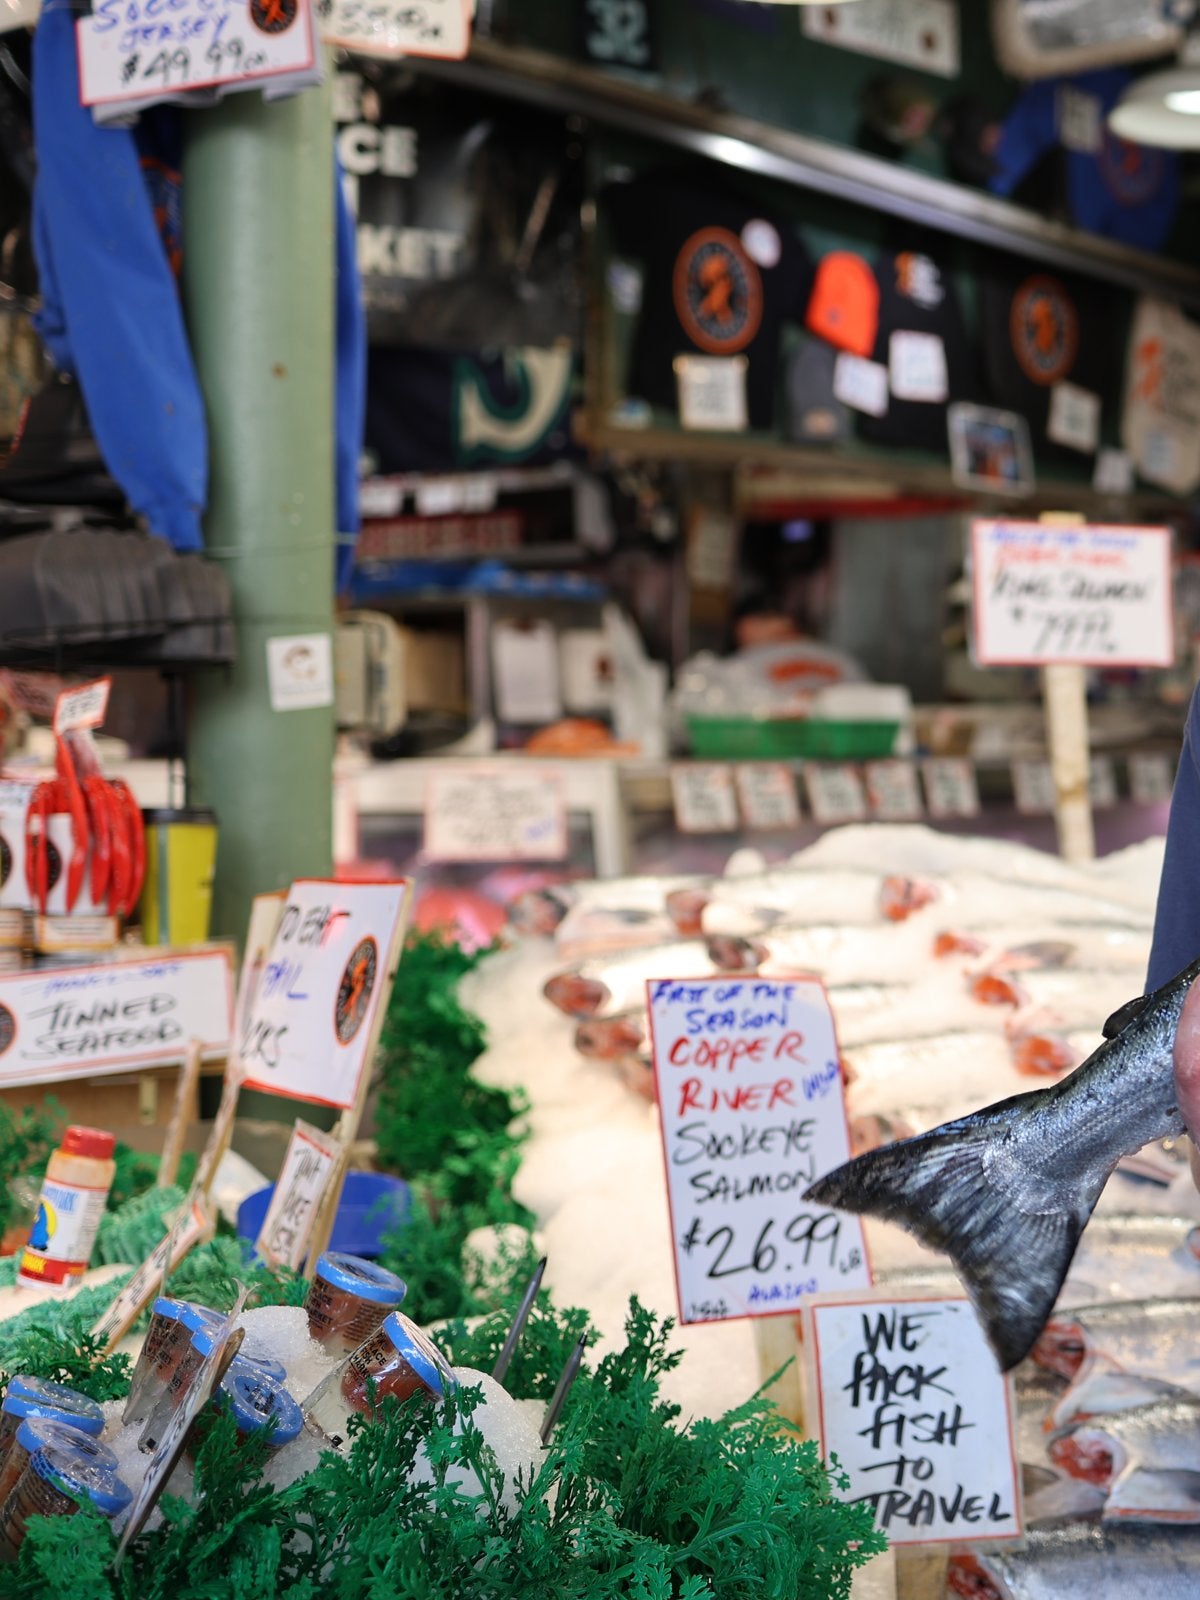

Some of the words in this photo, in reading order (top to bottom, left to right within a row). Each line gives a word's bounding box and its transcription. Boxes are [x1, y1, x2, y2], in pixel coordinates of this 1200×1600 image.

[119, 13, 229, 51] JERSEY
[26, 991, 178, 1032] TINNED
[714, 984, 744, 1003] OF
[752, 983, 796, 1000] THE
[20, 1016, 184, 1061] SEAFOOD
[686, 1002, 788, 1035] SEASON
[668, 1031, 807, 1073] COPPER
[678, 1077, 799, 1119] RIVER
[675, 1119, 816, 1166] SOCKEYE
[691, 1154, 816, 1203] SALMON
[680, 1213, 841, 1279] $26.99
[861, 1308, 942, 1354] WE
[843, 1352, 955, 1407] PACK
[858, 1403, 976, 1449] FISH
[860, 1455, 933, 1486] TO
[850, 1484, 1011, 1528] TRAVEL
